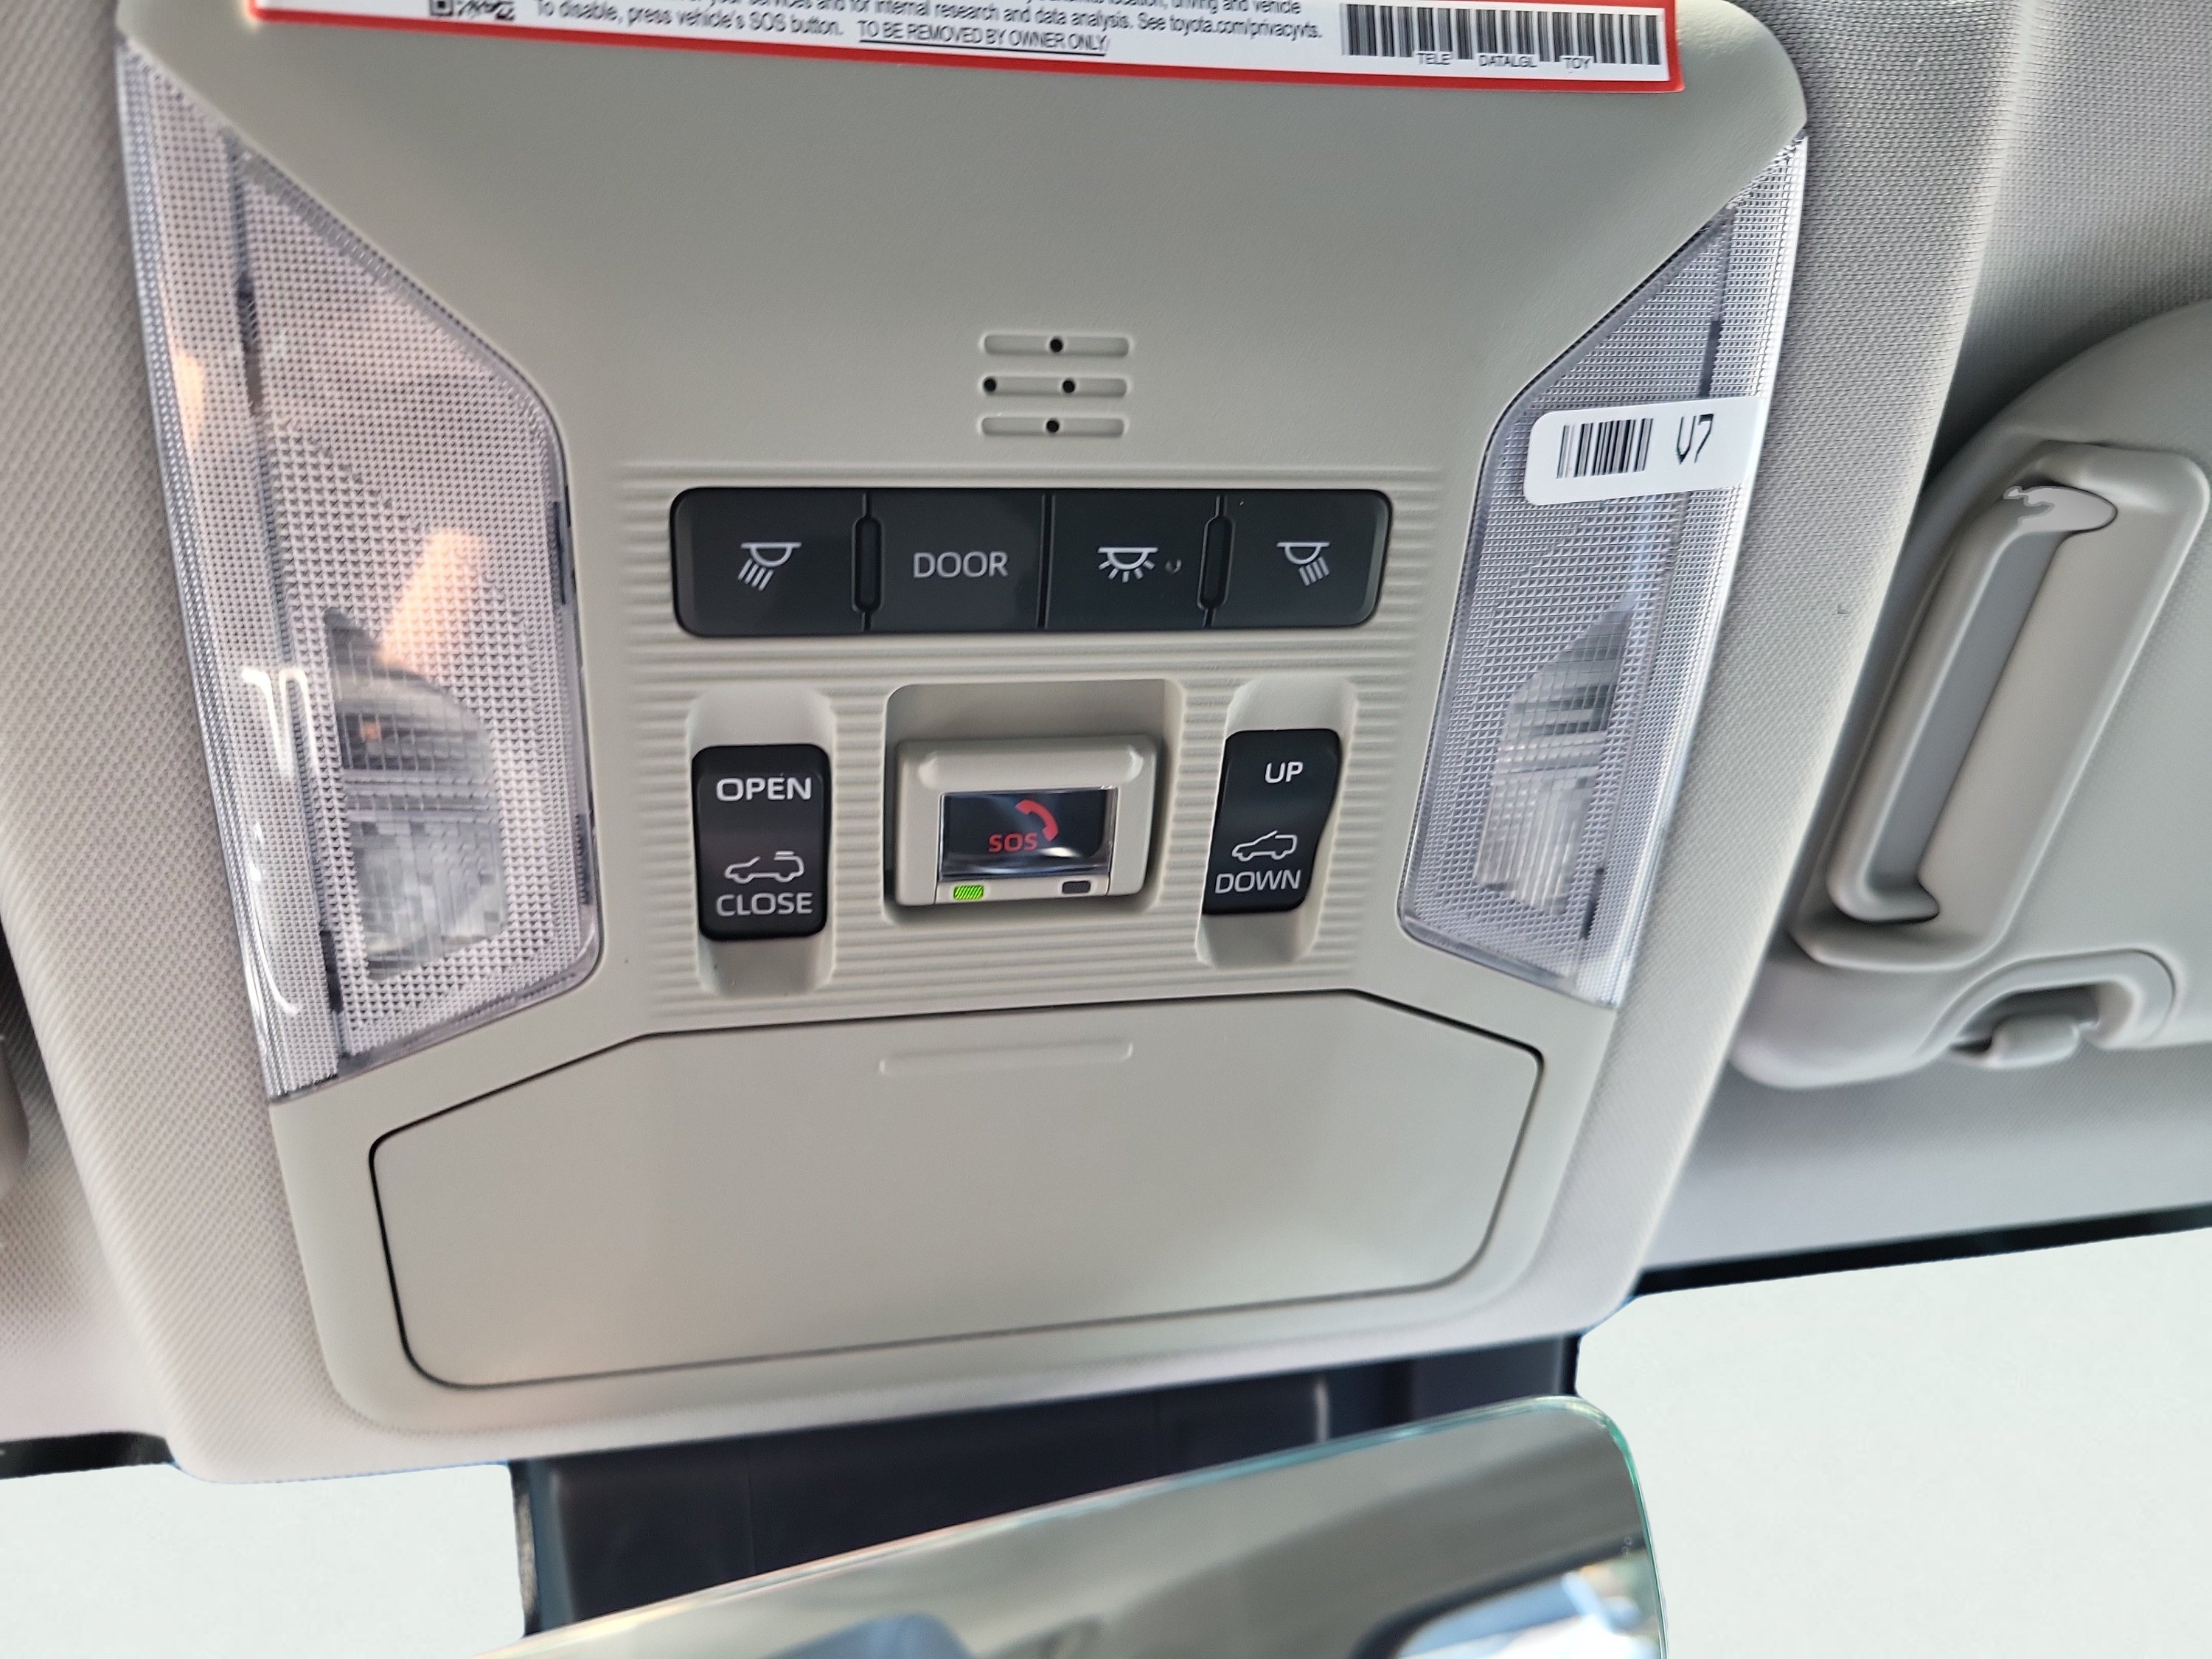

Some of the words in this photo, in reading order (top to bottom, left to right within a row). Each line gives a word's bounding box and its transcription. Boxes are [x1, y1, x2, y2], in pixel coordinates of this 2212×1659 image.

[934, 3, 999, 21] research
[1004, 5, 1031, 23] and
[1035, 7, 1066, 25] data
[1071, 10, 1133, 31] analysis.
[1137, 12, 1166, 29] See
[1253, 0, 1302, 14] vehicle
[559, 0, 622, 23] disable,
[627, 7, 672, 27] press
[676, 8, 745, 29] vehicle's
[749, 12, 786, 31] SOS
[790, 14, 844, 35] button.
[858, 20, 880, 37] TO
[883, 21, 903, 39] BE
[906, 24, 983, 44] REMOVED
[986, 28, 1007, 44] BY
[1007, 30, 1065, 49] OWNER
[1067, 33, 1107, 51] ONLY
[1416, 52, 1451, 65] TELE
[1564, 58, 1592, 69] TOY
[913, 552, 1008, 578] DOOR
[1265, 761, 1304, 784] UP
[716, 777, 812, 801] OPEN
[988, 832, 1038, 854] SOS
[1214, 869, 1302, 894] DOWN
[716, 892, 813, 917] CLOSE
